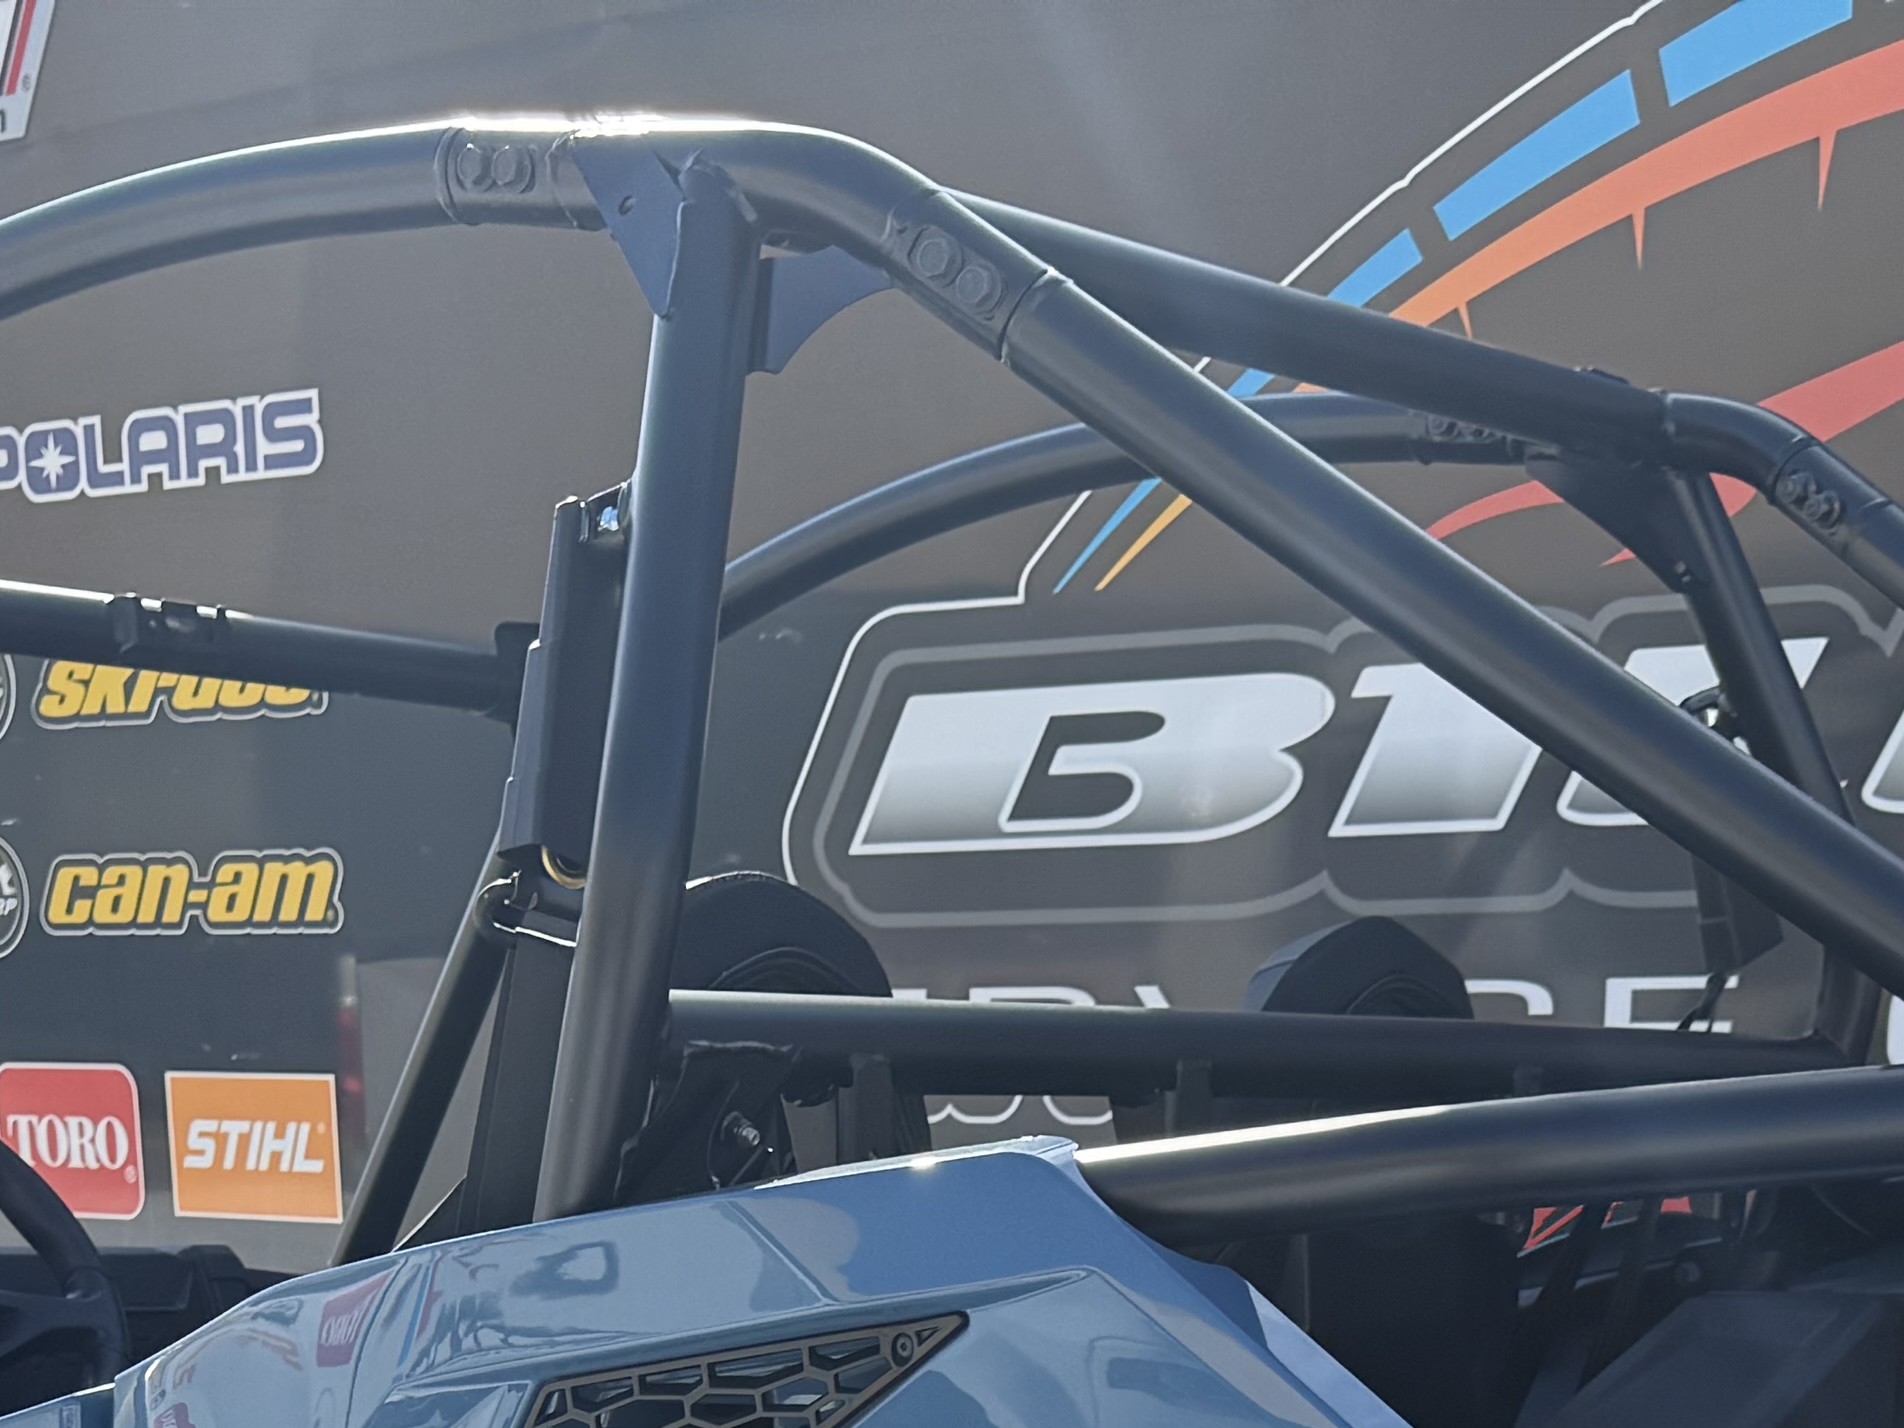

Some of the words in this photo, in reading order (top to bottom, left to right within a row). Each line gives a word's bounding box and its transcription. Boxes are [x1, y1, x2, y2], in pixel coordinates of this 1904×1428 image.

[44, 853, 340, 930] can-am
[6, 1113, 129, 1171] TORO
[183, 1119, 324, 1174] STIHL
